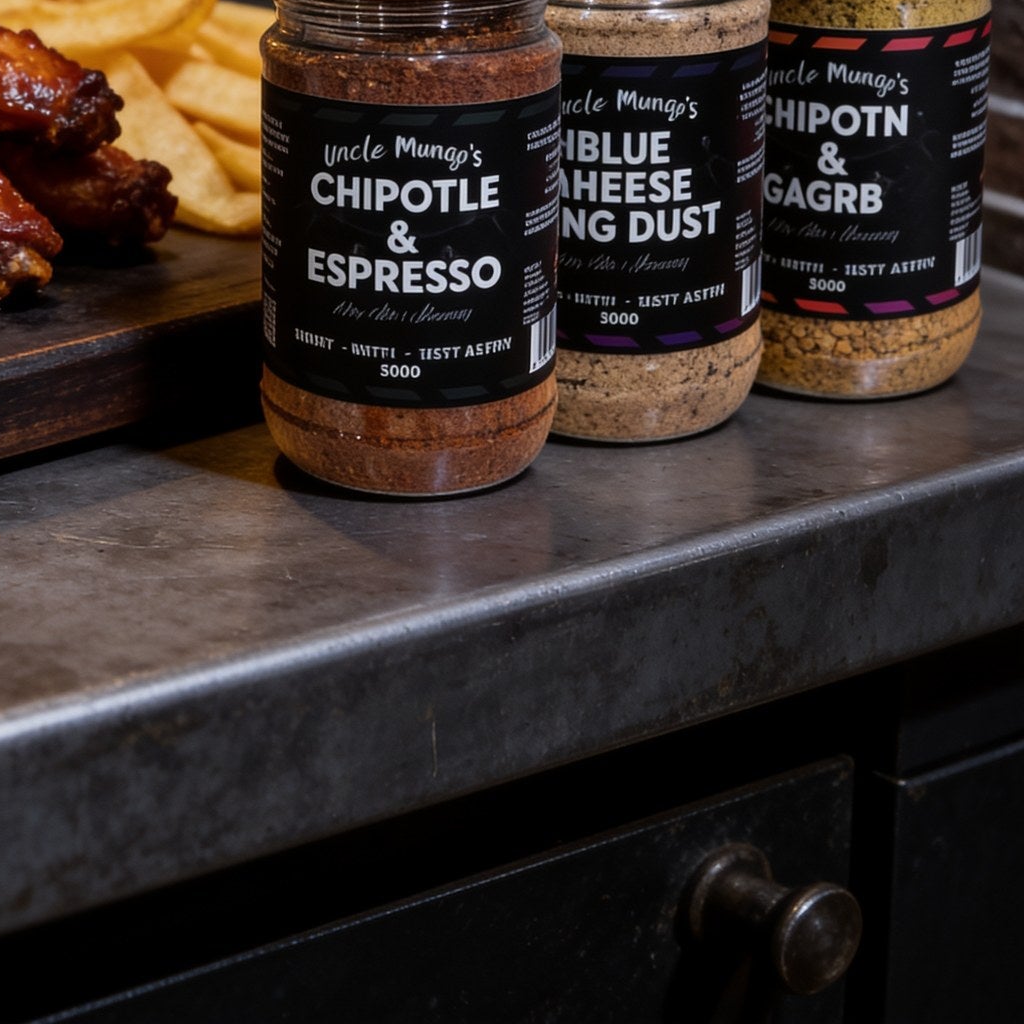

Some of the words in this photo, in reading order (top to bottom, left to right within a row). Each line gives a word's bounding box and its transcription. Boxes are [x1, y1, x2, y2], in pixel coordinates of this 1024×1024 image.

[324, 134, 387, 167] Uncle
[395, 135, 482, 171] Mungo's
[817, 141, 848, 176] &
[310, 172, 500, 213] CHIPOTLE
[763, 172, 883, 214] GAGRB
[387, 220, 419, 254] &
[629, 201, 721, 244] DUST
[307, 248, 501, 294] ESPRESSO
